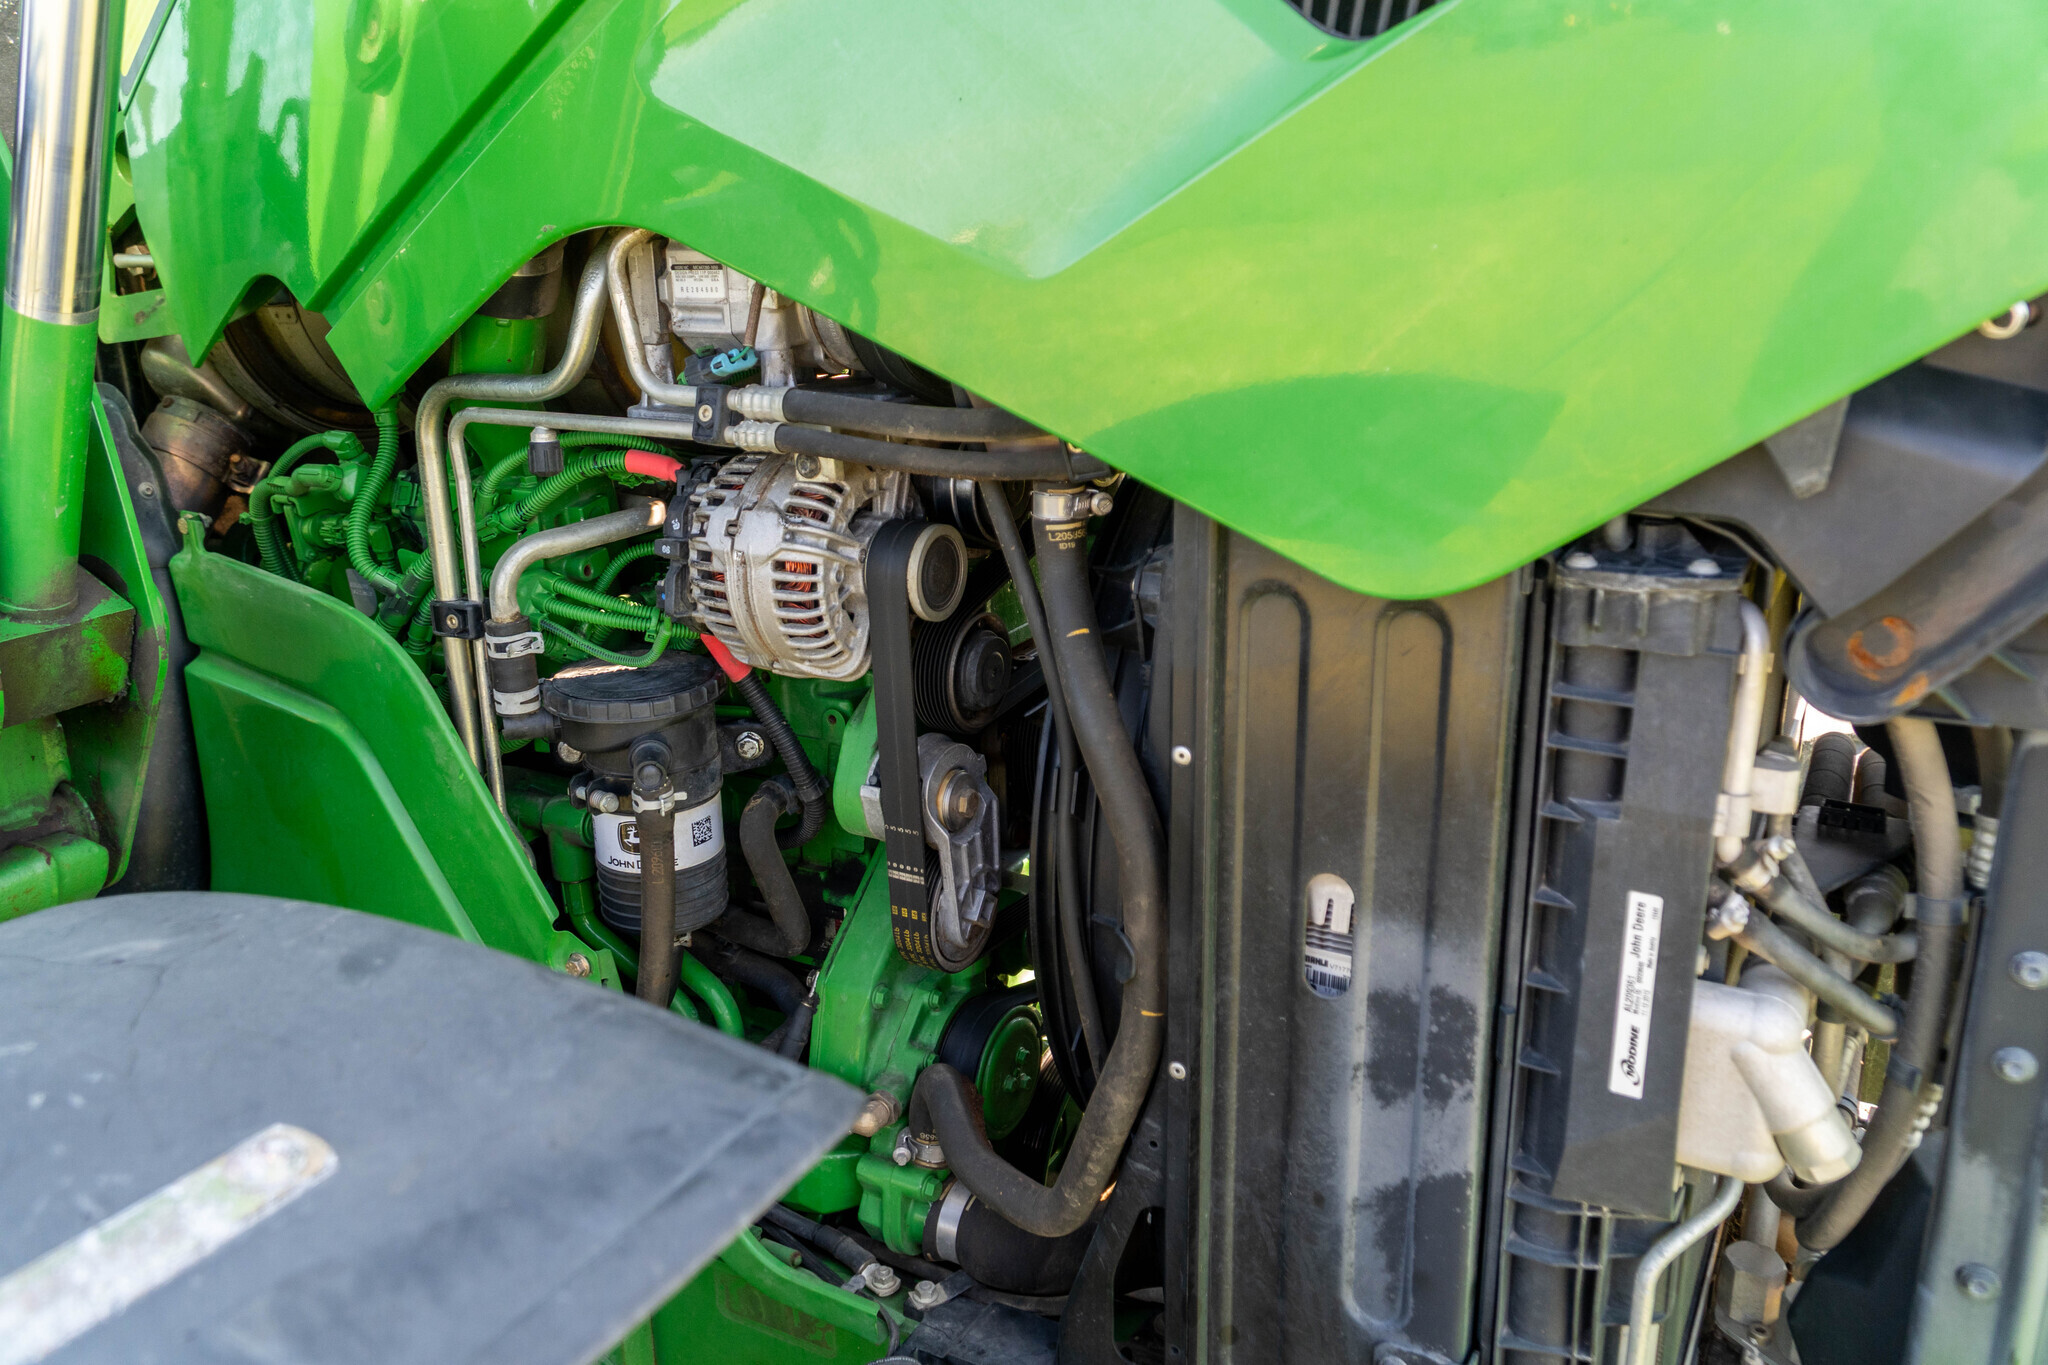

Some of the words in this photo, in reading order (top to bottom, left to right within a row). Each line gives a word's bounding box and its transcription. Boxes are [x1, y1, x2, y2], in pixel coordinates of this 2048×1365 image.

[608, 855, 635, 869] JOHN
[1632, 901, 1648, 932] Deere
[1629, 934, 1643, 959] John
[1625, 1024, 1641, 1077] MODINE
